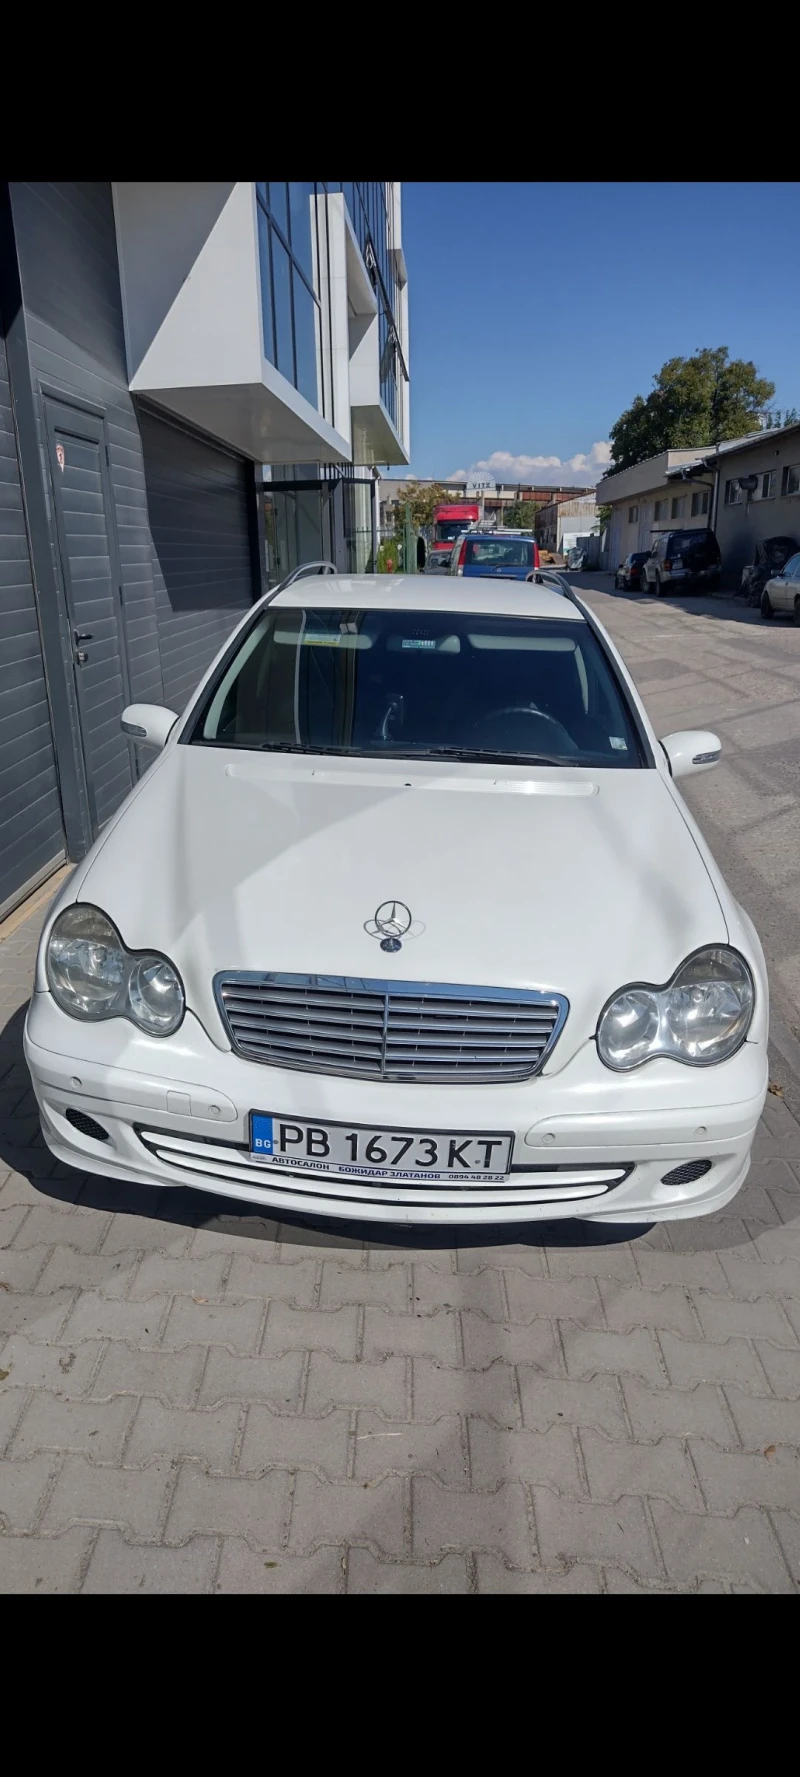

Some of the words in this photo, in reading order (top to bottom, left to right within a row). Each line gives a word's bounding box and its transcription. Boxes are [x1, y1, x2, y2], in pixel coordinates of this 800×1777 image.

[255, 1138, 271, 1149] BG
[279, 1123, 331, 1157] PB
[345, 1133, 438, 1167] 1673
[447, 1139, 503, 1168] KT
[272, 1157, 330, 1170] АВТОСАЛОН
[338, 1166, 388, 1177] БОЖИДАР
[389, 1172, 441, 1180] ЗЛАТАНОВ
